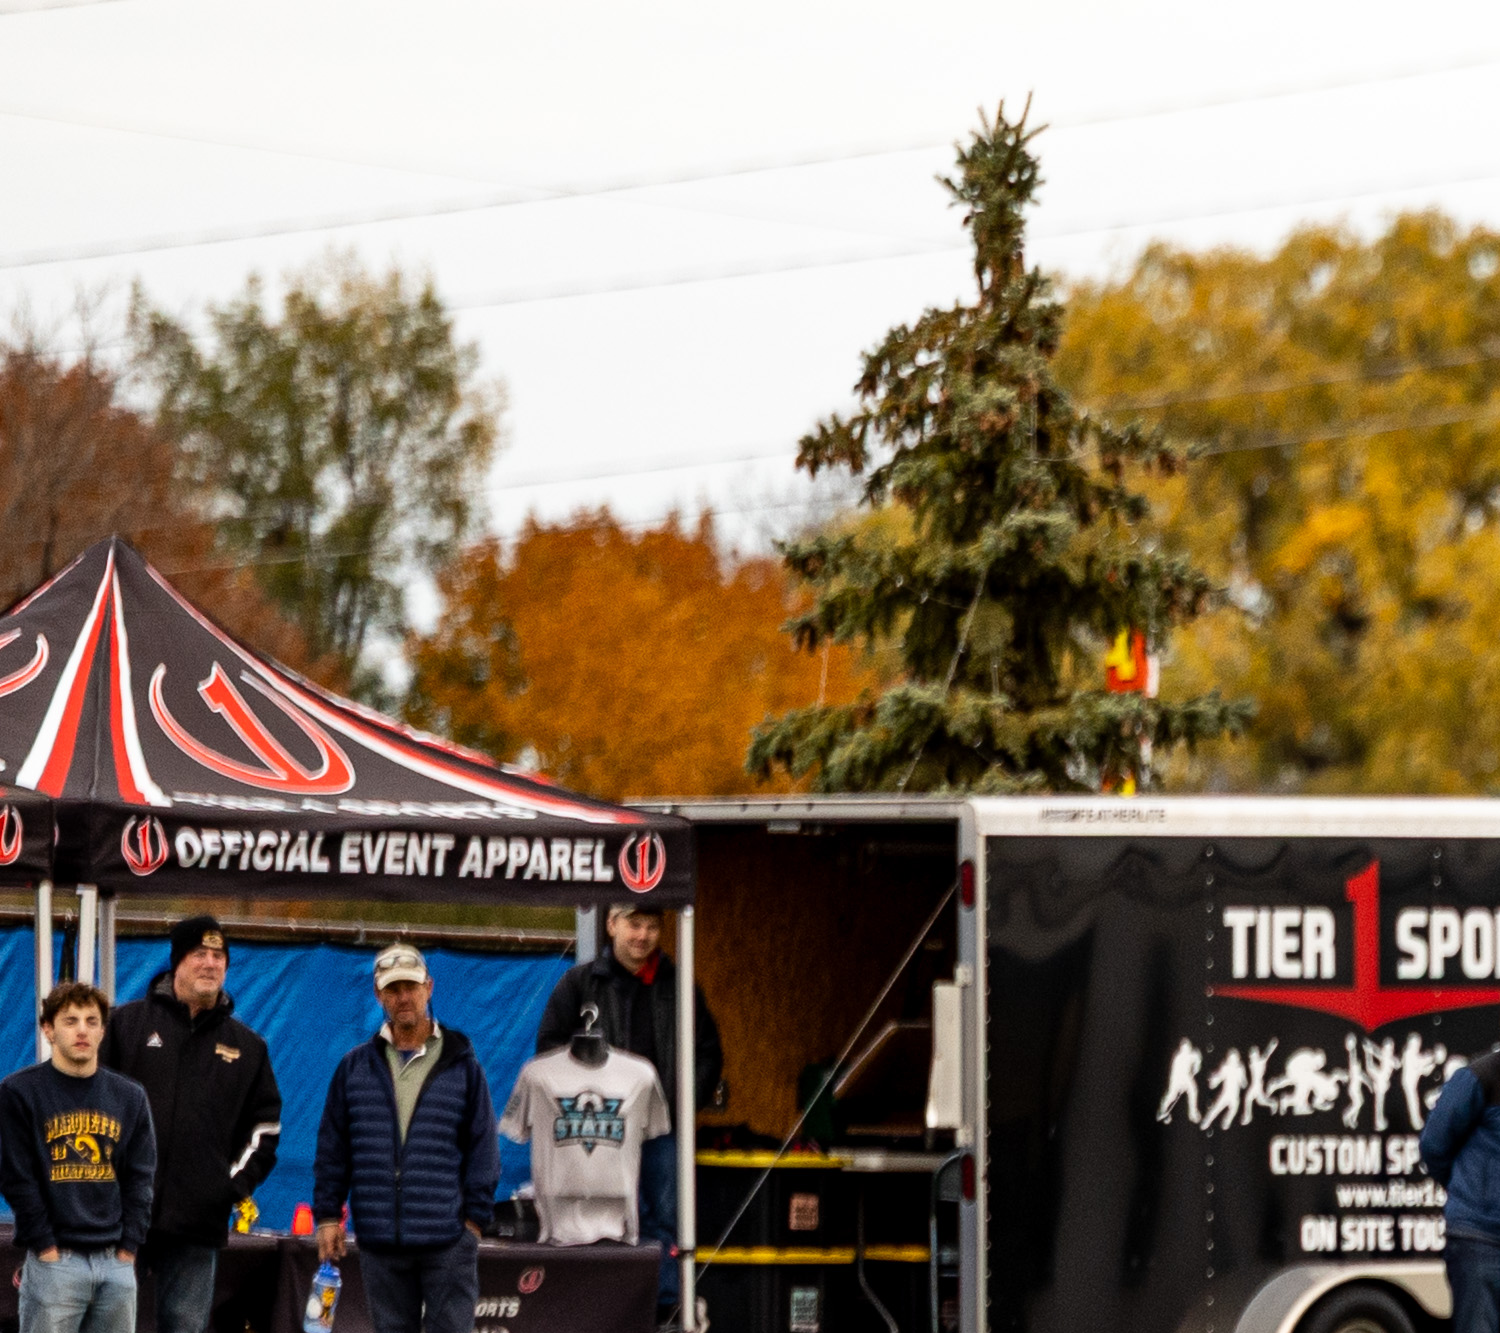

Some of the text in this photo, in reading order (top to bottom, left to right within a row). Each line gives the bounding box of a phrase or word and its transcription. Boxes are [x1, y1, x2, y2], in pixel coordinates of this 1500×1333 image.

[175, 828, 614, 882] OFFICIAL EVENT APPAREL
[1223, 906, 1337, 980] TIER
[553, 1116, 624, 1143] STATE
[1269, 1135, 1382, 1175] CUSTOM
[1300, 1215, 1337, 1252] ON
[1340, 1215, 1395, 1252] SITE
[474, 1296, 521, 1318] ORTS
